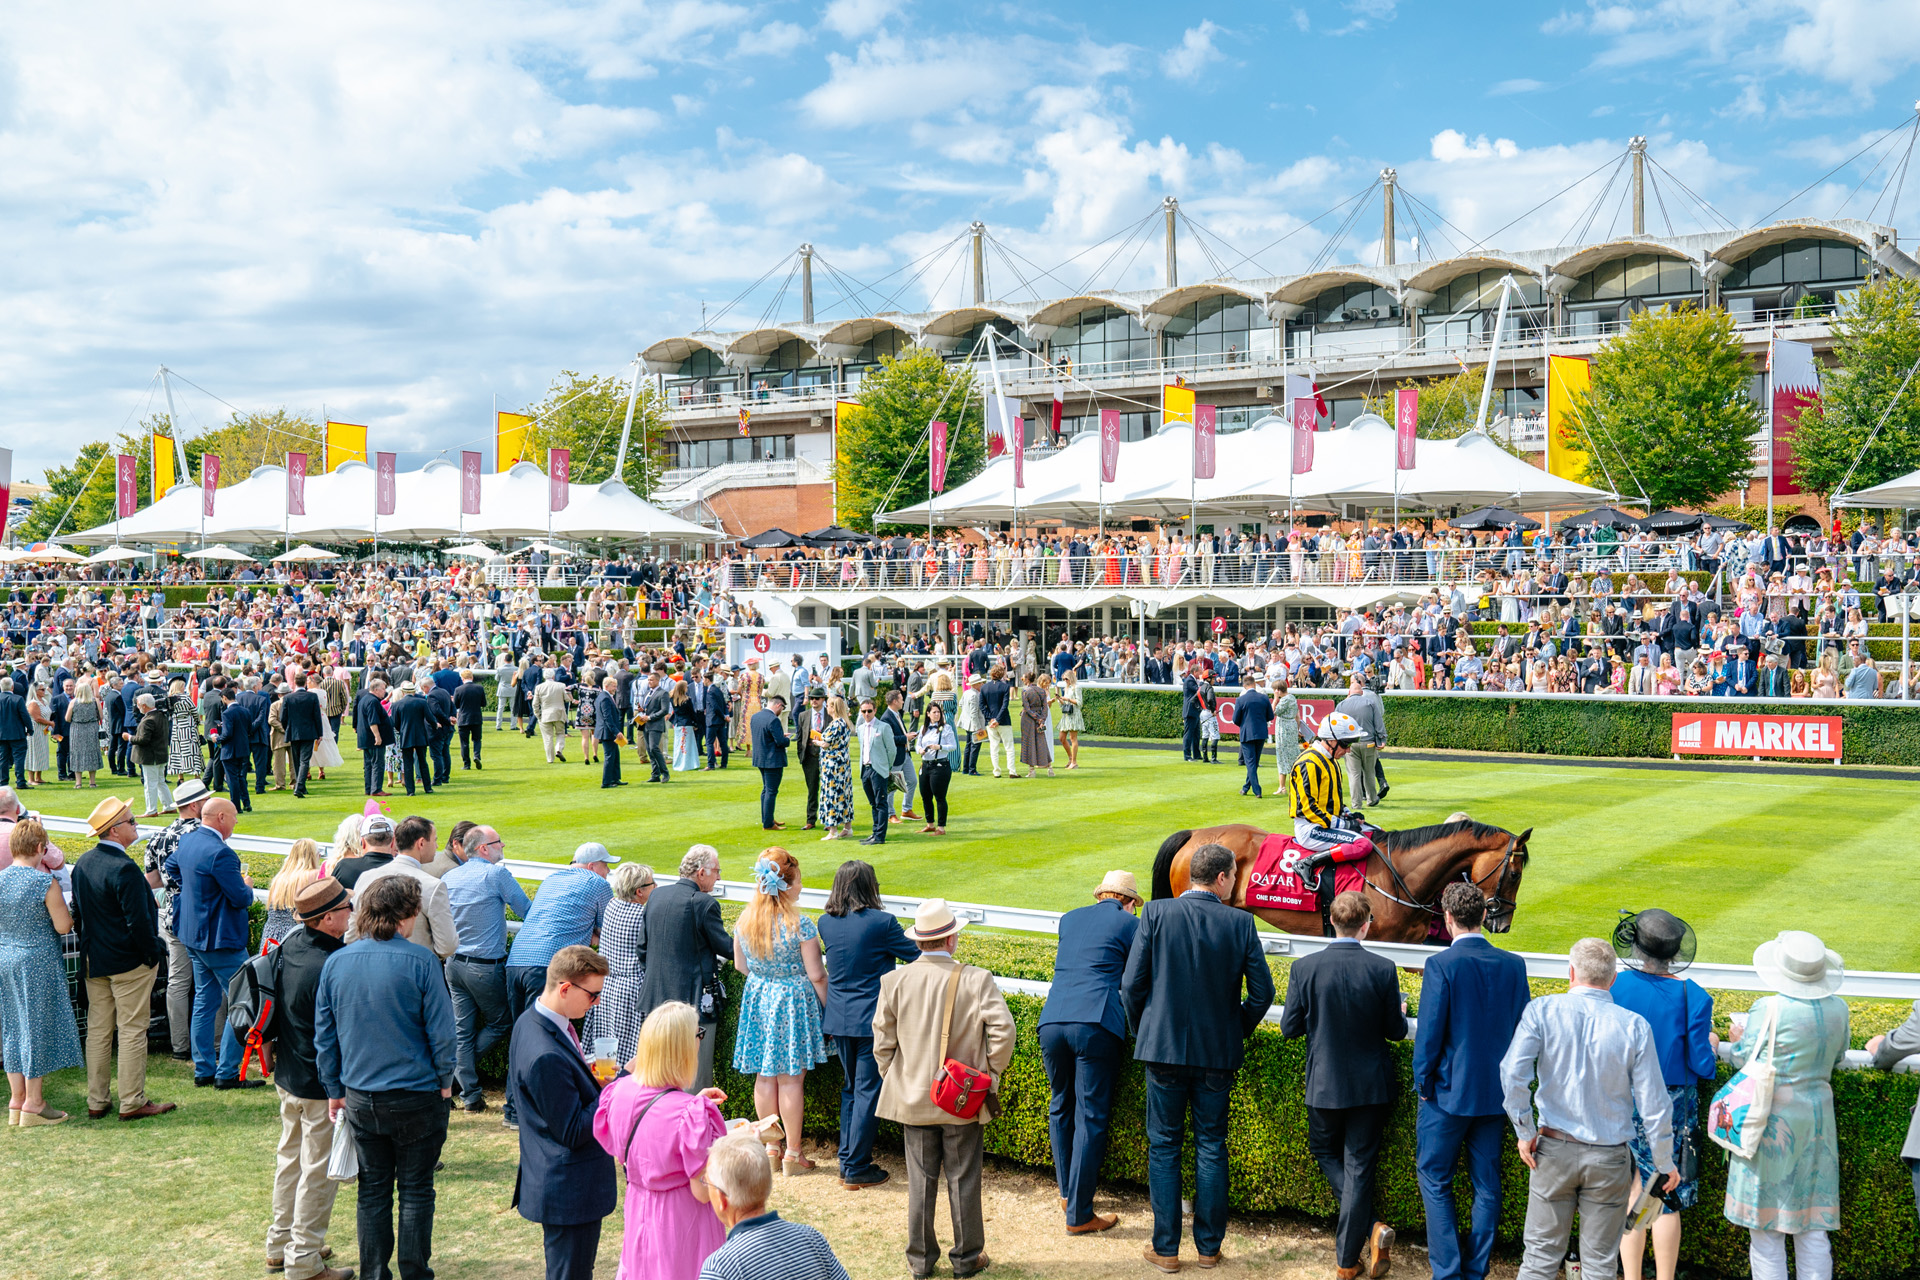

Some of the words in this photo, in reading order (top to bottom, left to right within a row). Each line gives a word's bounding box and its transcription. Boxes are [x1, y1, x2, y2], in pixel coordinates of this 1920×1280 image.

[952, 621, 959, 634] 1
[1214, 619, 1223, 632] 2
[757, 636, 766, 651] 4
[1714, 720, 1835, 752] MARKEL
[1311, 829, 1337, 839] SPORTING
[1337, 833, 1353, 842] INDEX
[1279, 849, 1301, 873] 8
[1251, 872, 1295, 887] QATAR
[1282, 897, 1303, 905] BOBBY
